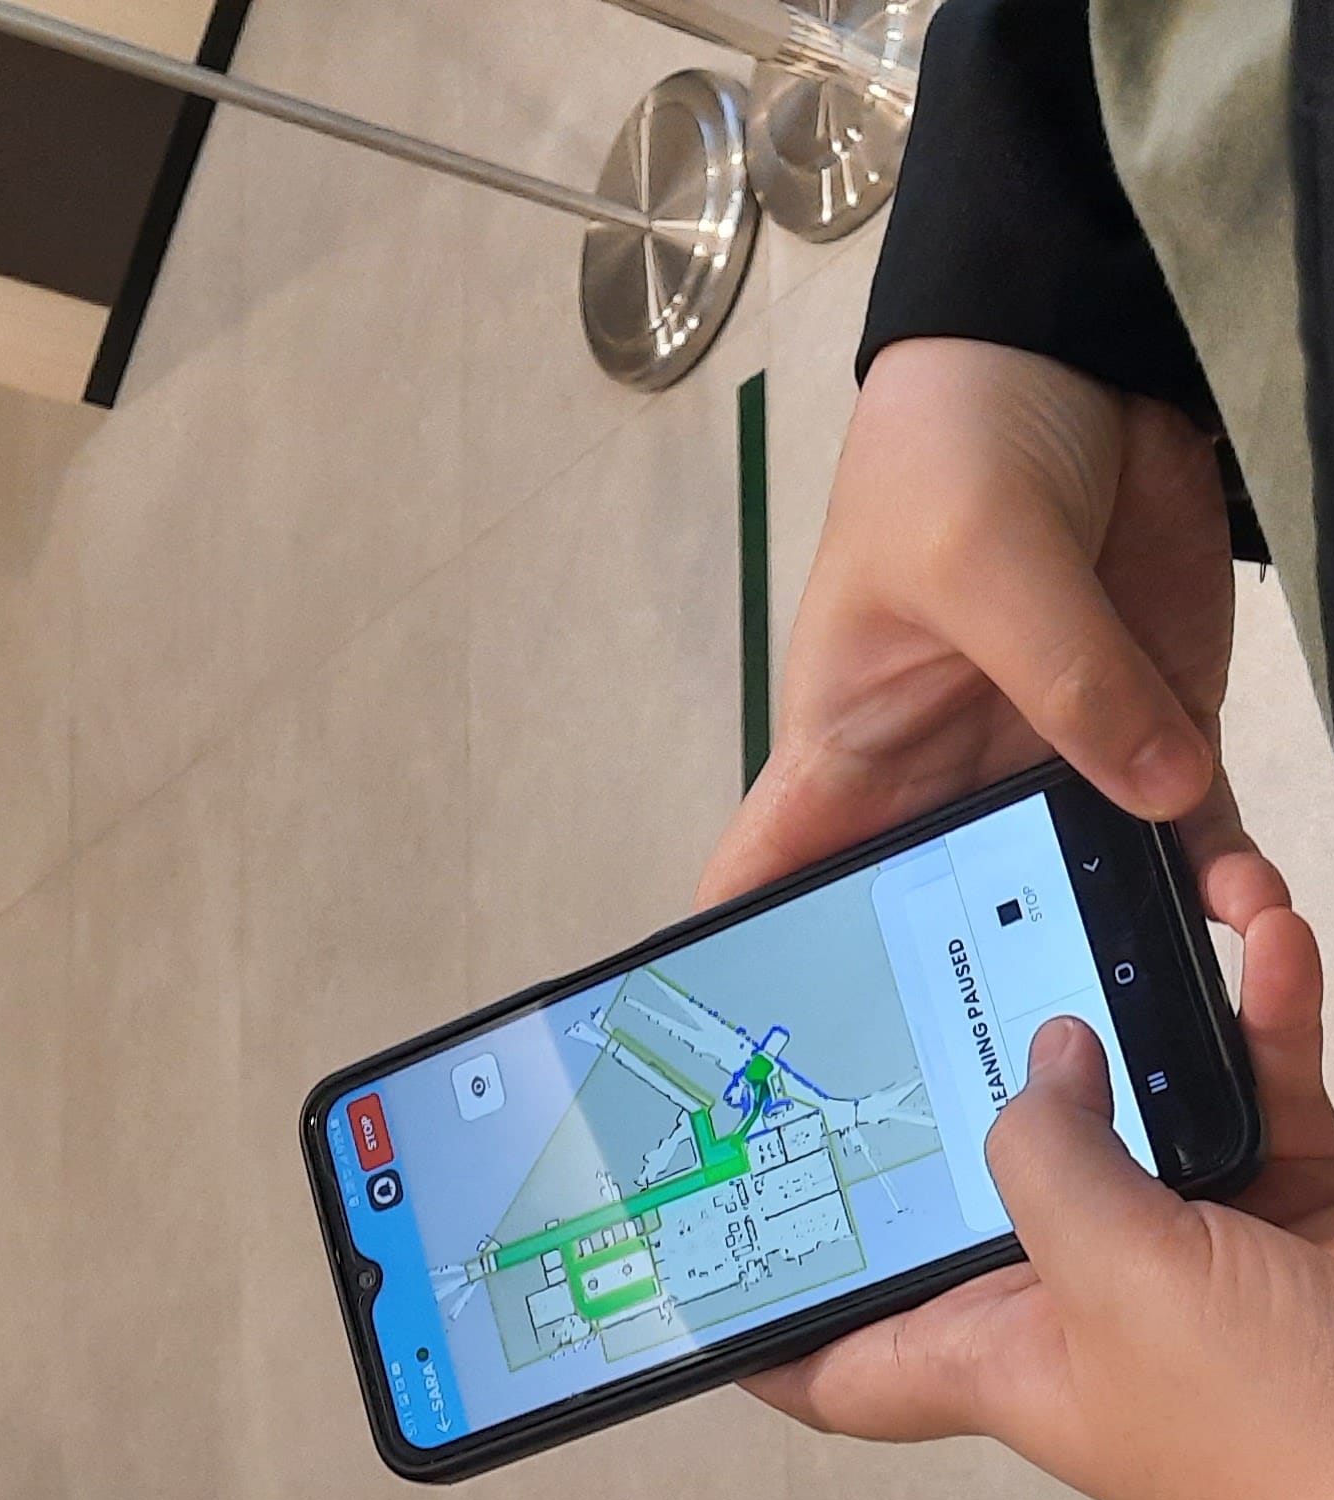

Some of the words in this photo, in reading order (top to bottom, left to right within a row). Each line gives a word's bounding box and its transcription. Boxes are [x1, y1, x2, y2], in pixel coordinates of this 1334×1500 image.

[1022, 885, 1043, 923] STOP
[948, 938, 984, 1019] PAUSED
[972, 1022, 1009, 1112] LEANING
[360, 1115, 377, 1151] STOP
[422, 1361, 444, 1412] SARA
